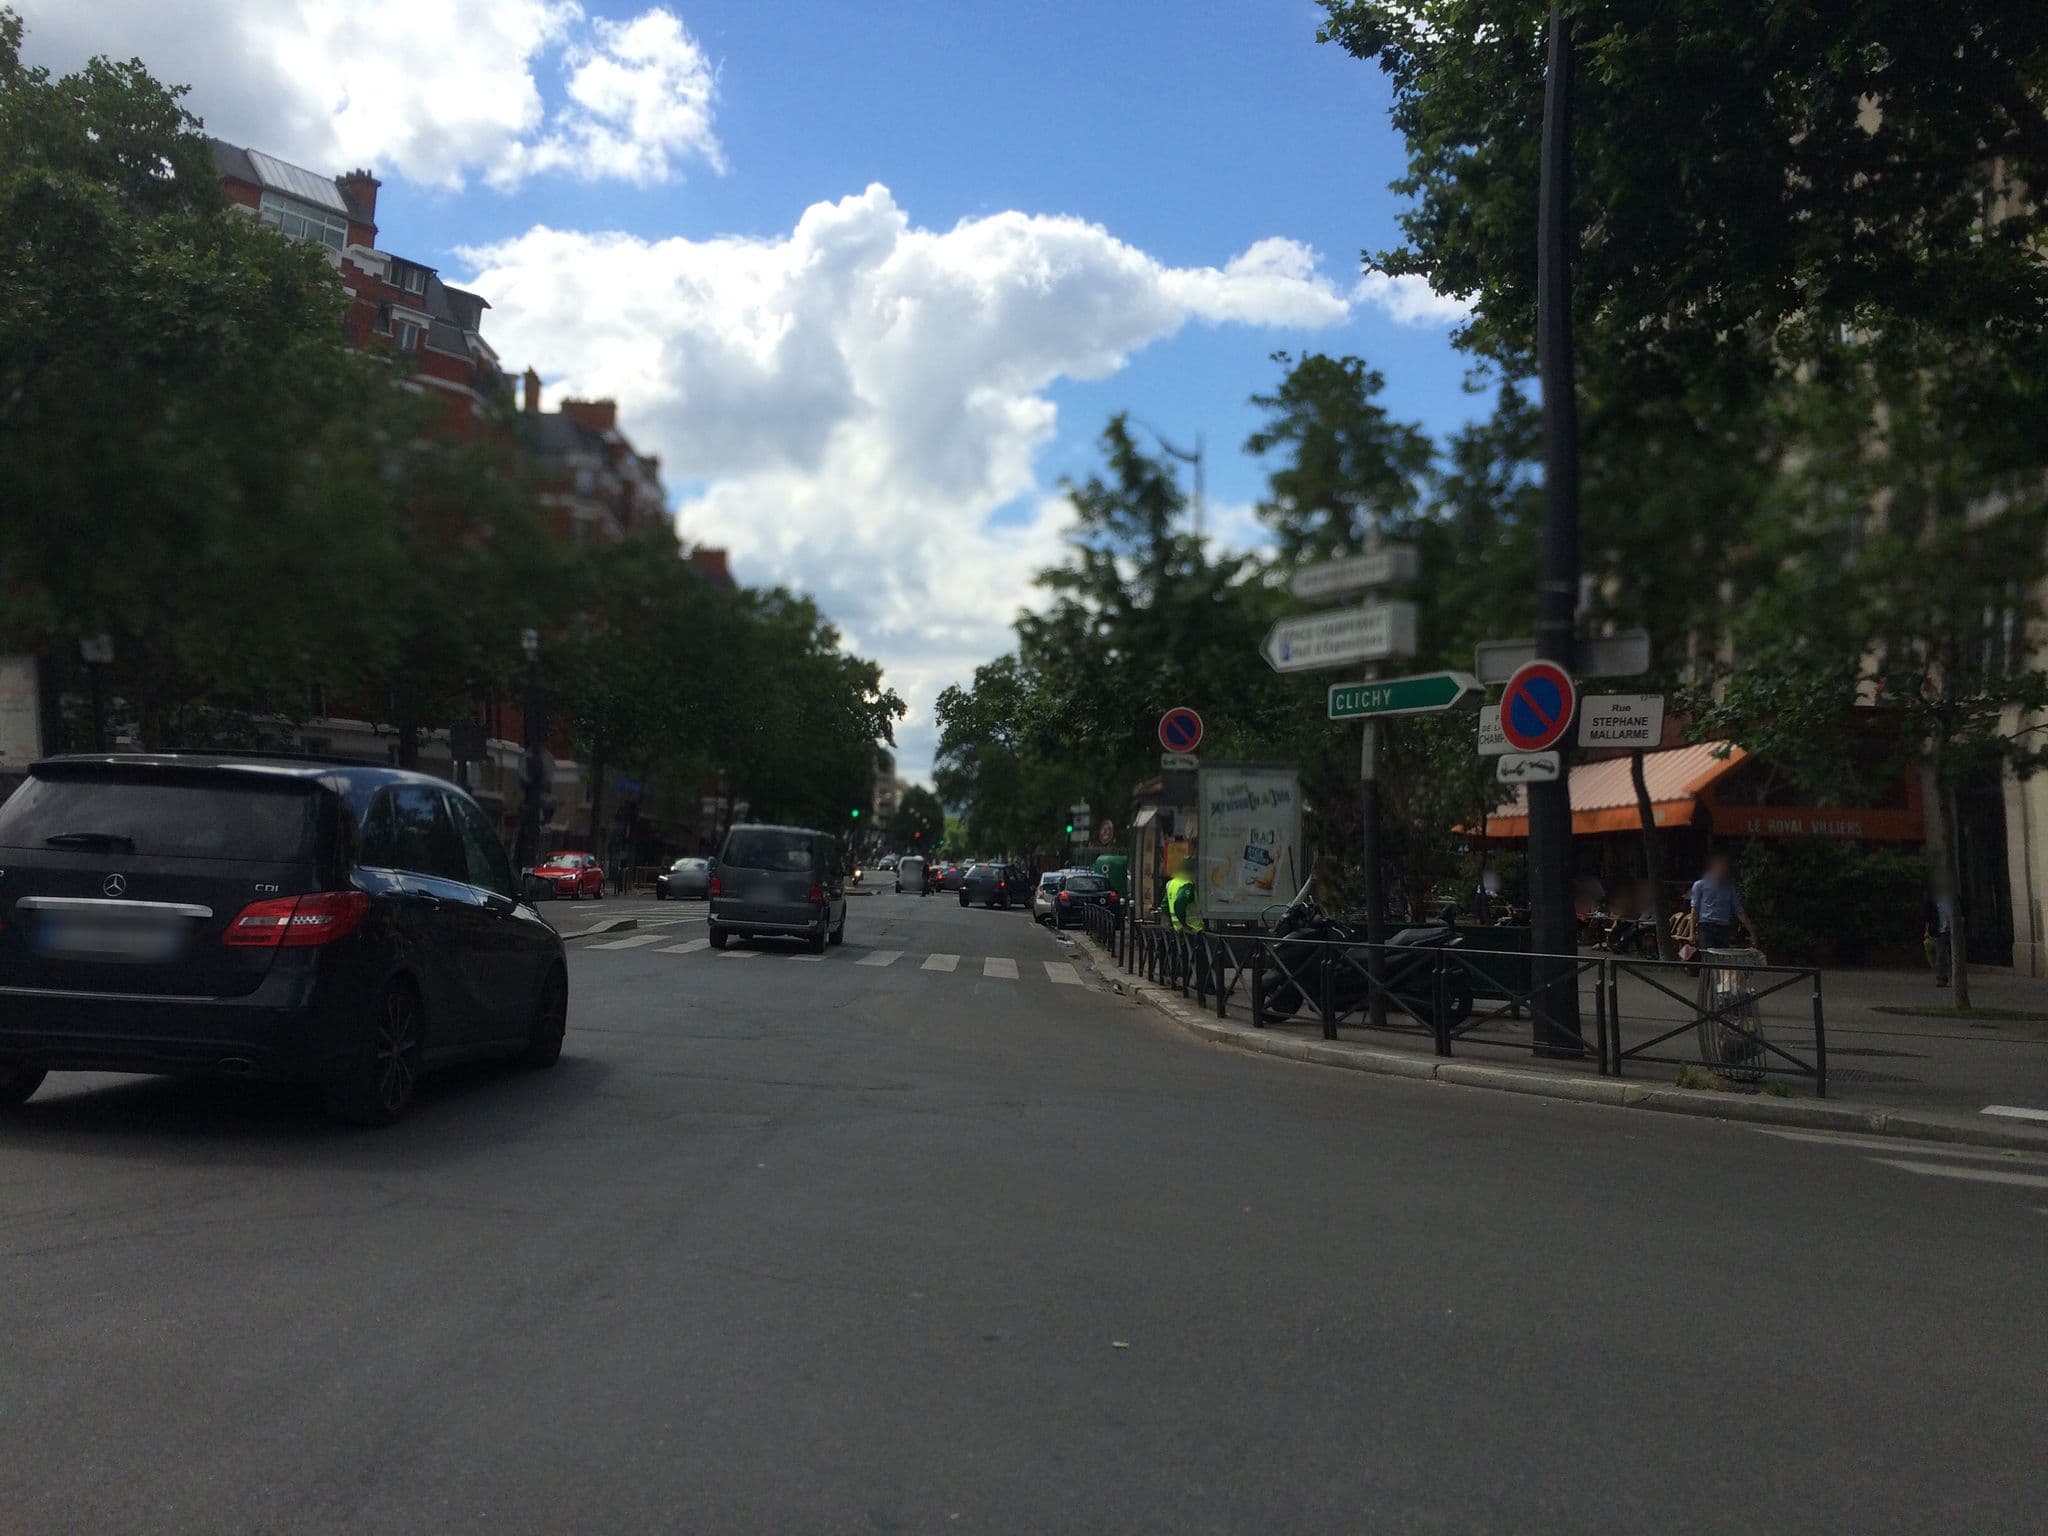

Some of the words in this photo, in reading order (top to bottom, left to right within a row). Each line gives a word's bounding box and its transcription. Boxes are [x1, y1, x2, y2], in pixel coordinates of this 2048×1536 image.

[1336, 688, 1392, 710] CLICHY
[1612, 704, 1632, 712] Rue
[1592, 717, 1648, 727] STEPHANE
[1590, 729, 1648, 739] MALLARME
[1767, 819, 1803, 833] ROYAL
[1811, 820, 1863, 833] VILLIERS
